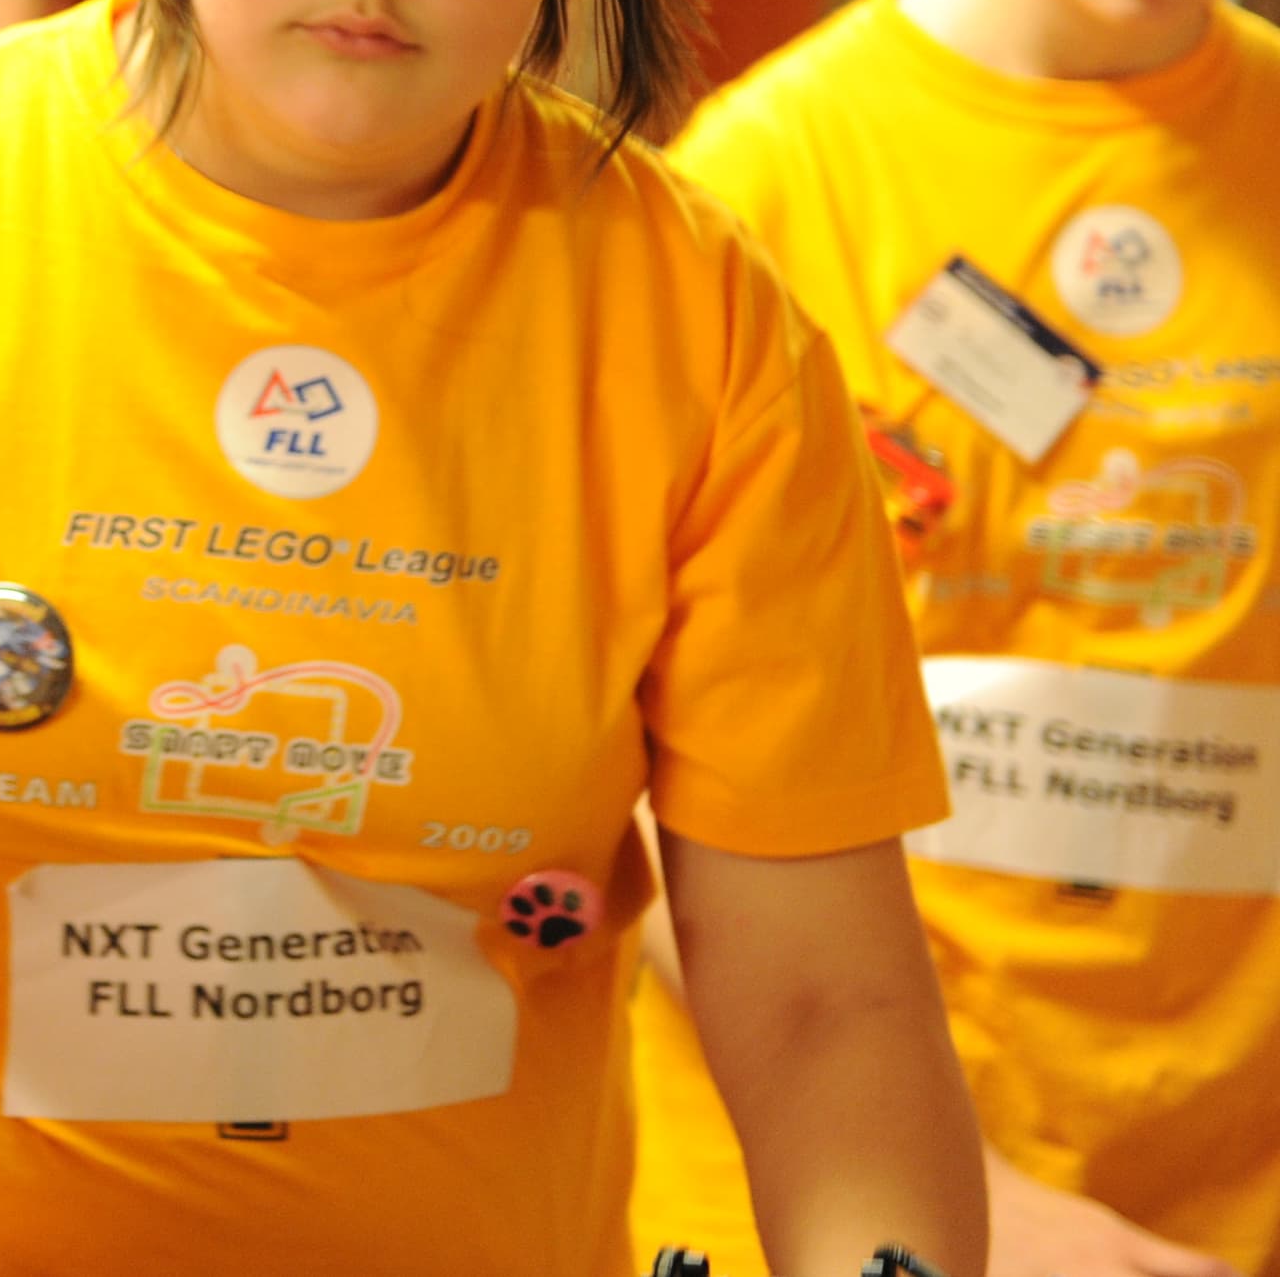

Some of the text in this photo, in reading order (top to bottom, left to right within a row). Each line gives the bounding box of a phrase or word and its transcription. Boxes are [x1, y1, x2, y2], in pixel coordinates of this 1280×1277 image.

[263, 428, 326, 456] FLL
[62, 512, 500, 584] FIRST LEGO League
[140, 574, 418, 626] SCANDINAVIA
[938, 707, 1021, 742] NXT
[122, 722, 410, 784] SMART MOVE
[955, 756, 1235, 827] FLL Nordborg
[419, 820, 534, 856] 2009
[62, 922, 159, 958] NXT
[88, 978, 423, 1020] FLL Nordborg
